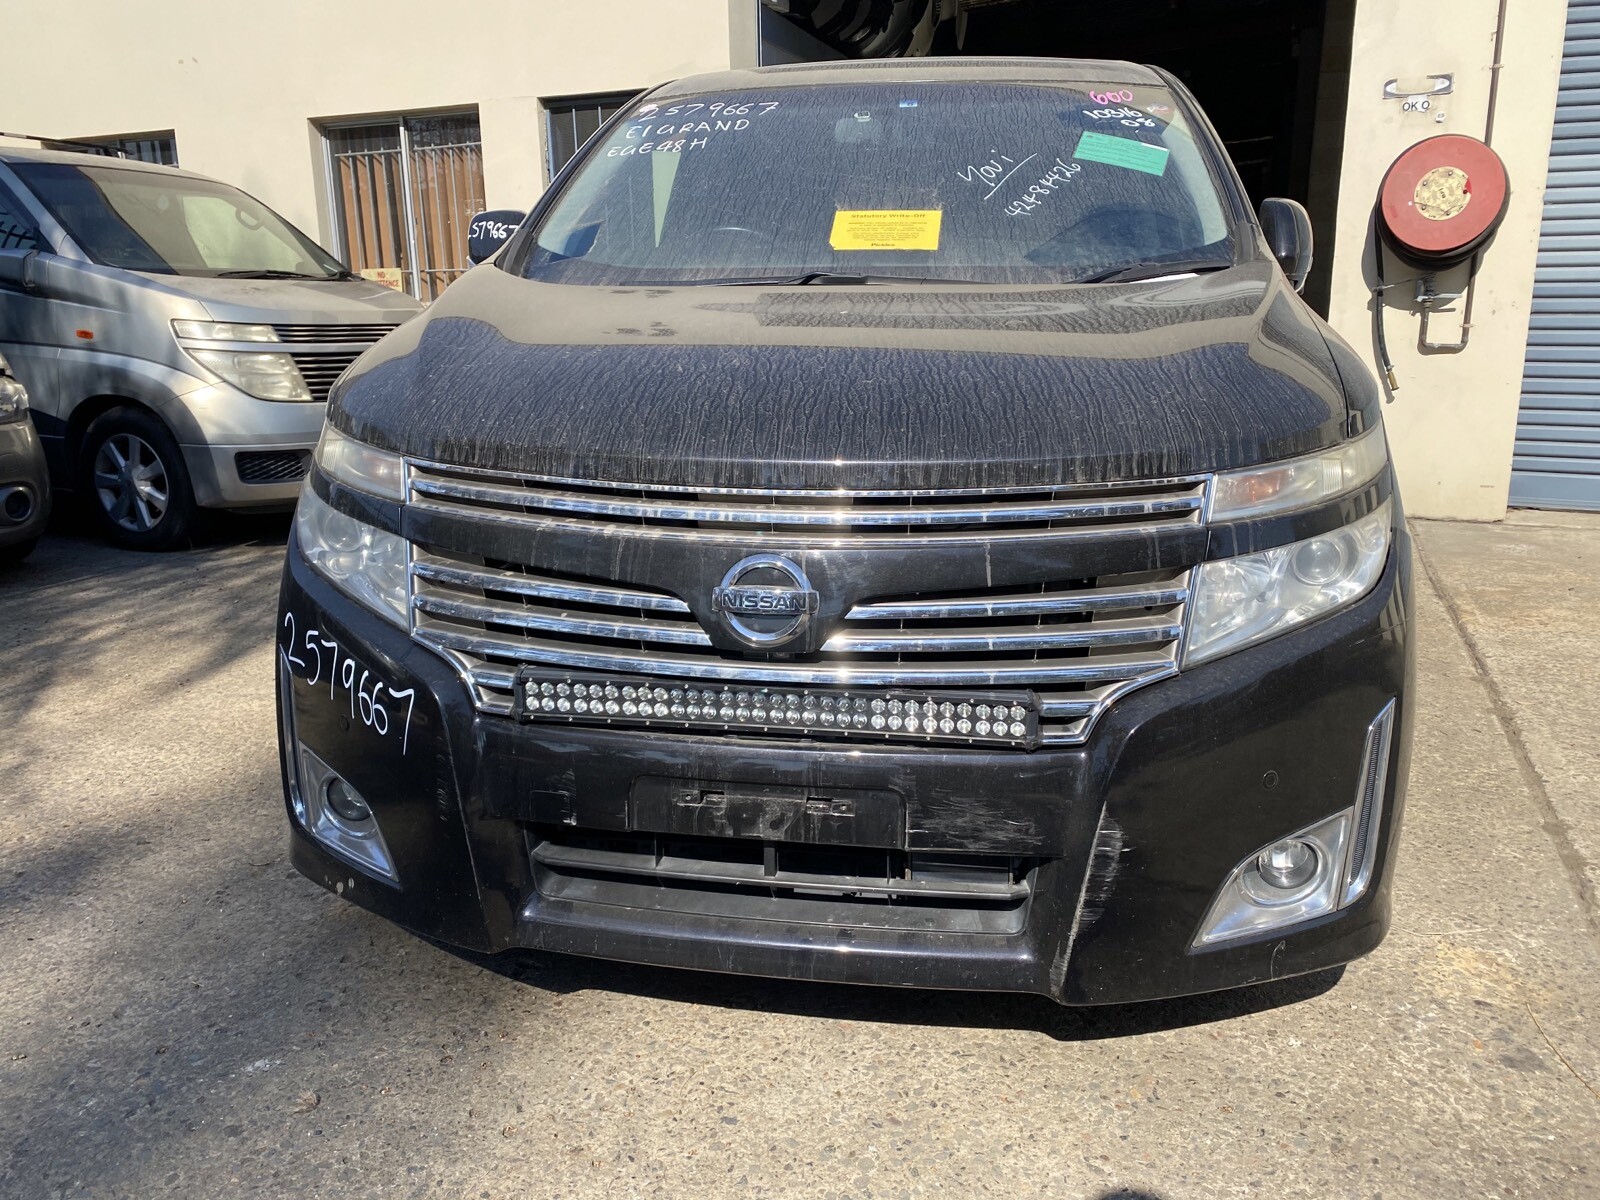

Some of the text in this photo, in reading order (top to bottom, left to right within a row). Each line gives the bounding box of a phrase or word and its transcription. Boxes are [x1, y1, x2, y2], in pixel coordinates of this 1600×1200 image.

[1089, 89, 1133, 105] 600
[1402, 101, 1418, 112] OK
[638, 101, 779, 123] 2579667
[468, 220, 519, 240] 579667
[721, 592, 806, 611] NISSAN
[284, 611, 415, 756] 2579667
